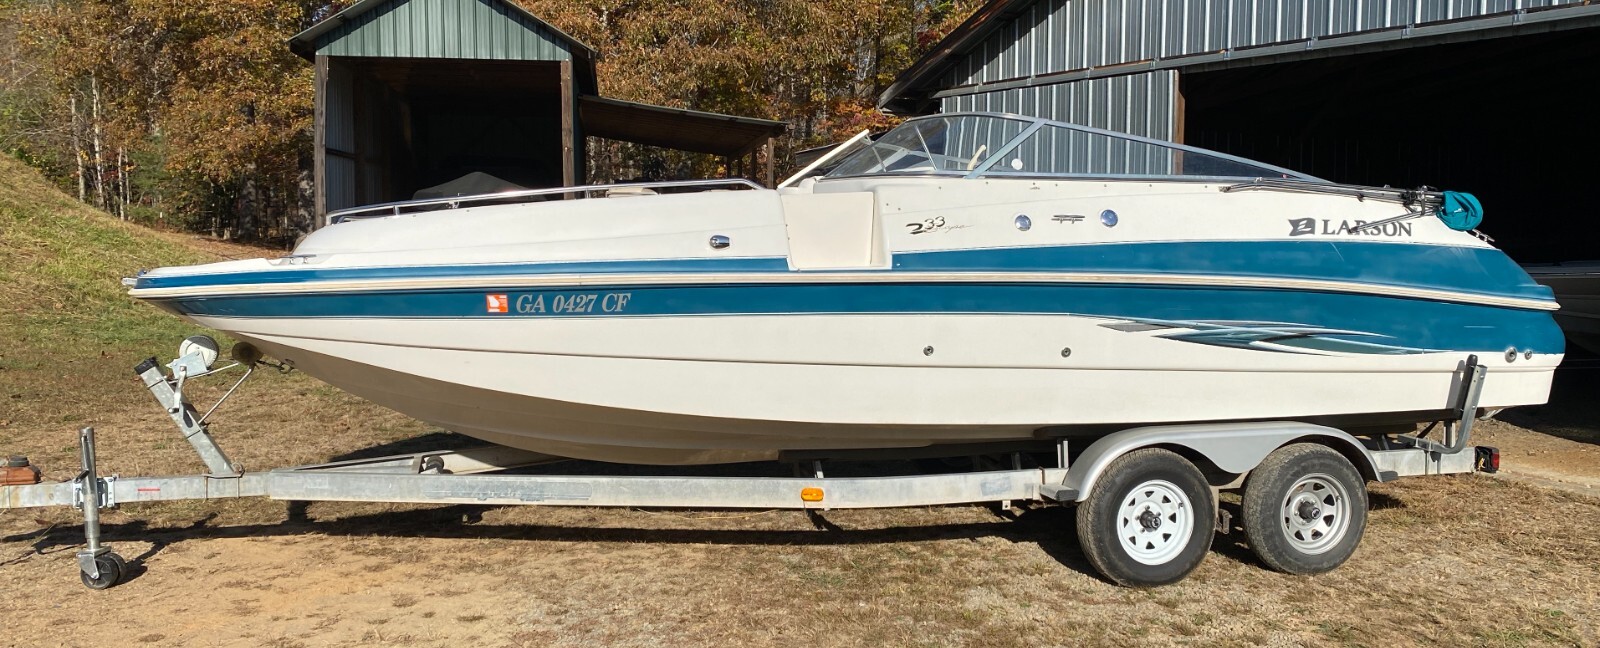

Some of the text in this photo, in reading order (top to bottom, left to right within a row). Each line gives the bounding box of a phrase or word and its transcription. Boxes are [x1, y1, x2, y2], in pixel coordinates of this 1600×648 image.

[905, 215, 946, 235] 233
[515, 294, 546, 313] GA
[552, 294, 598, 313] 0427
[601, 292, 632, 312] CF
